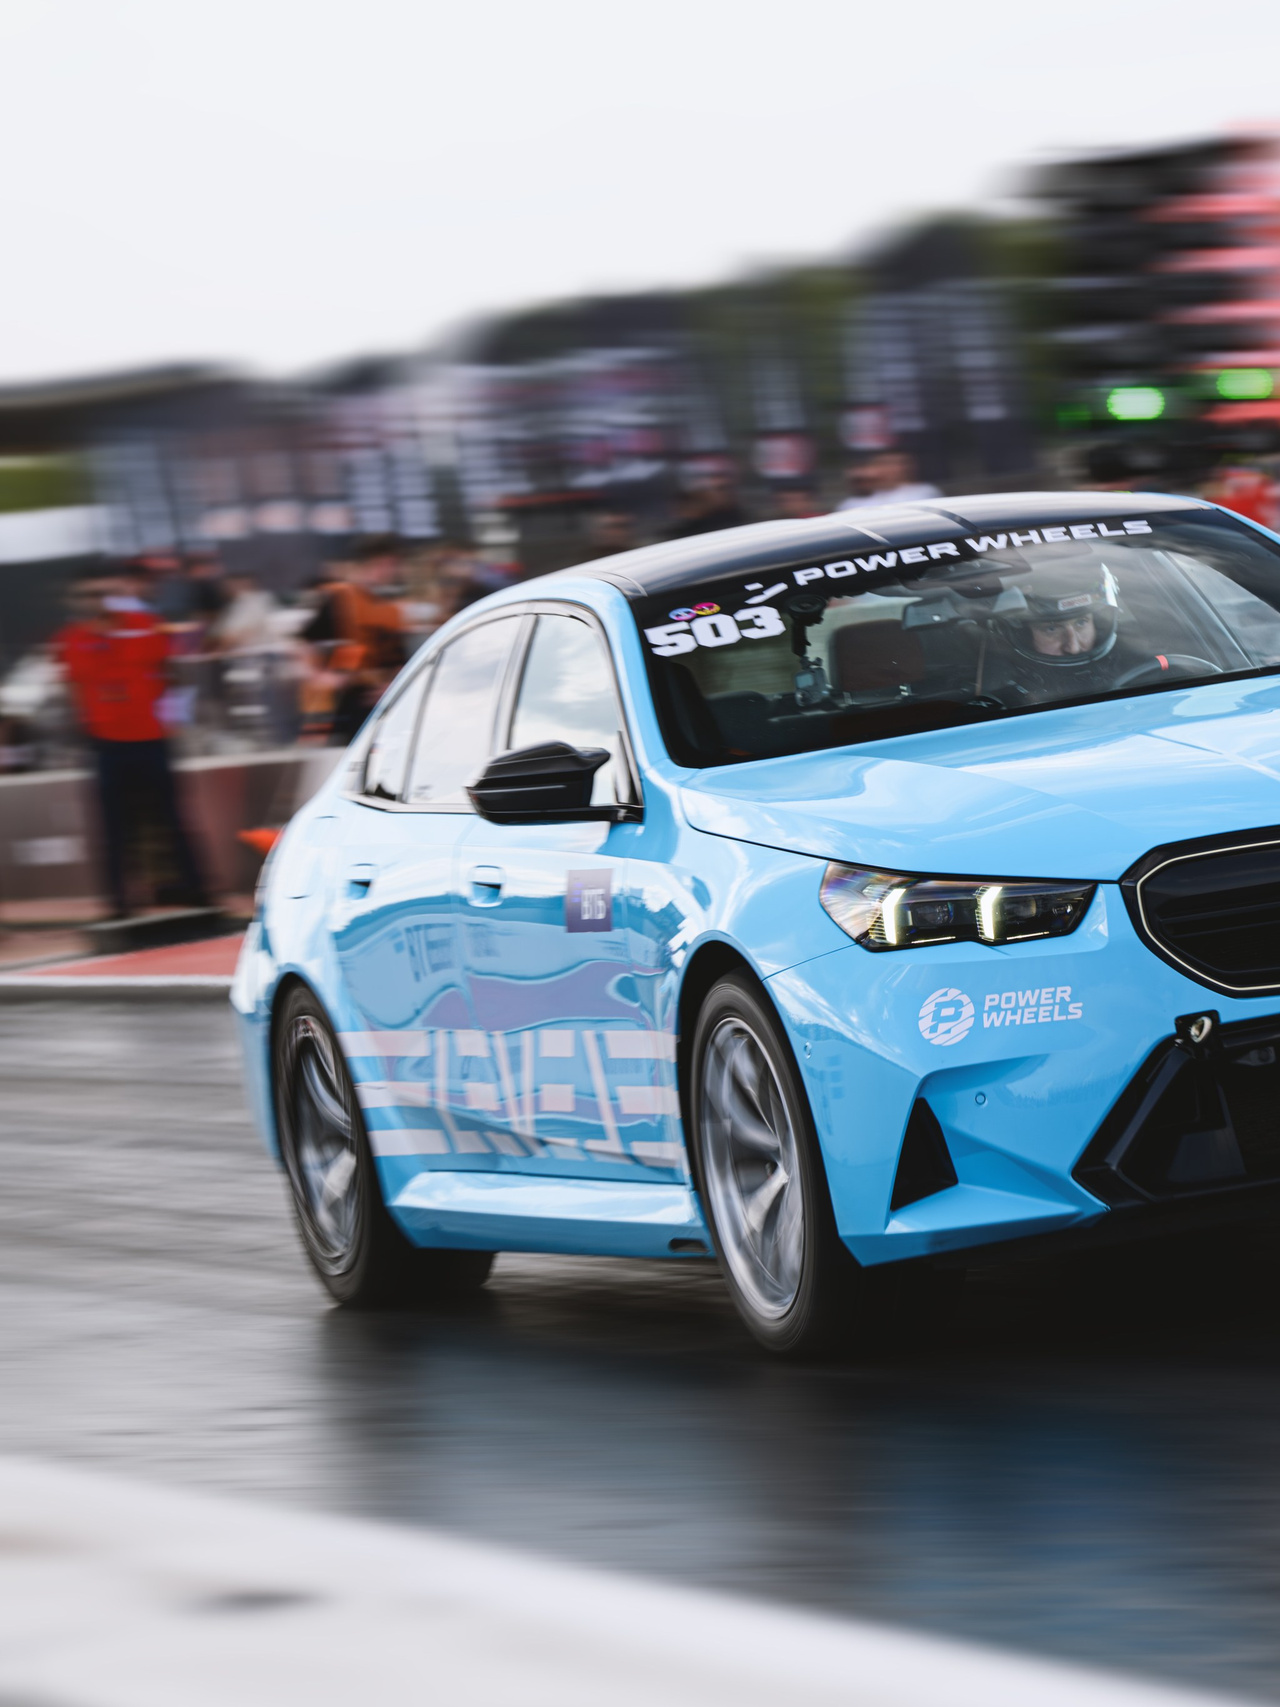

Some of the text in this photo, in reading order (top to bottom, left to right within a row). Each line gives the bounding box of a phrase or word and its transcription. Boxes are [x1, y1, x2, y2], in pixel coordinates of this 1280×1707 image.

[792, 519, 1153, 586] POWER WHEELS
[643, 605, 786, 657] 503
[983, 1002, 1083, 1028] WHEELS
[984, 986, 1072, 1011] POWER
